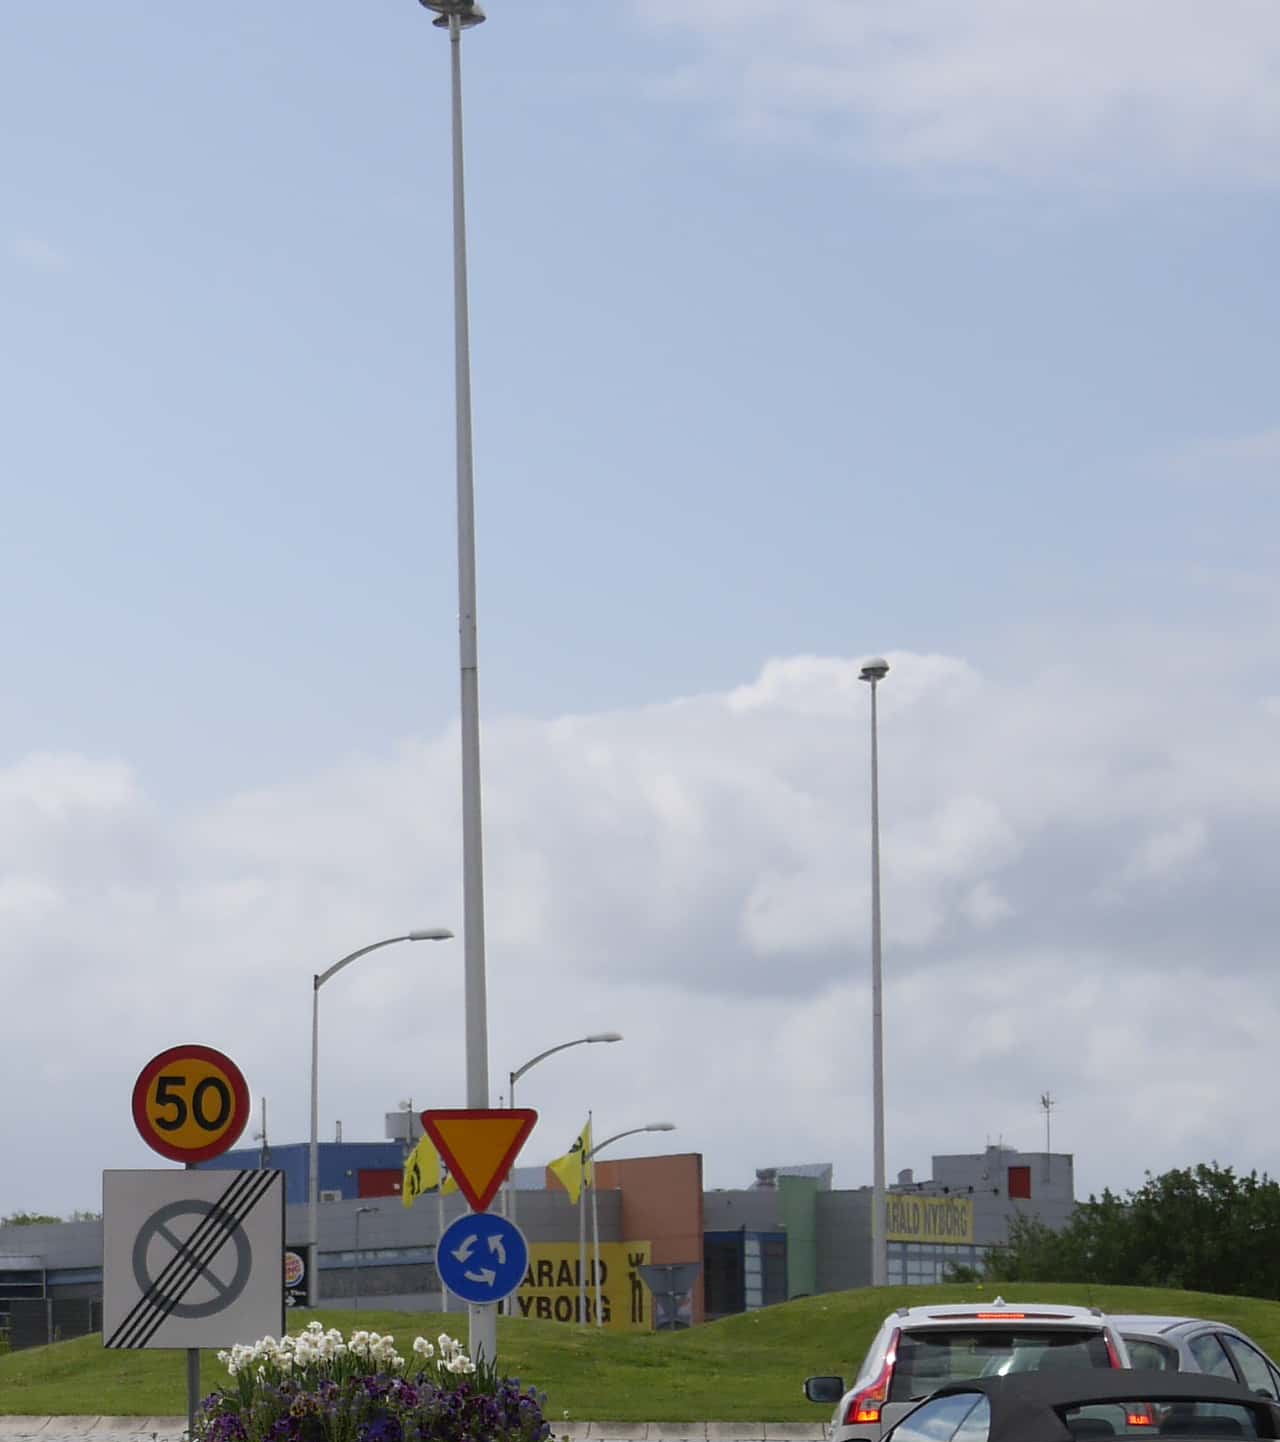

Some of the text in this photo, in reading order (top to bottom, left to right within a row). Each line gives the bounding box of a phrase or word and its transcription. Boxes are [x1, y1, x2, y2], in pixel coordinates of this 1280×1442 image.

[154, 1075, 231, 1131] 50
[886, 1200, 920, 1234] ARALD
[520, 1259, 608, 1288] ARALD
[498, 1295, 612, 1324] YBORG
